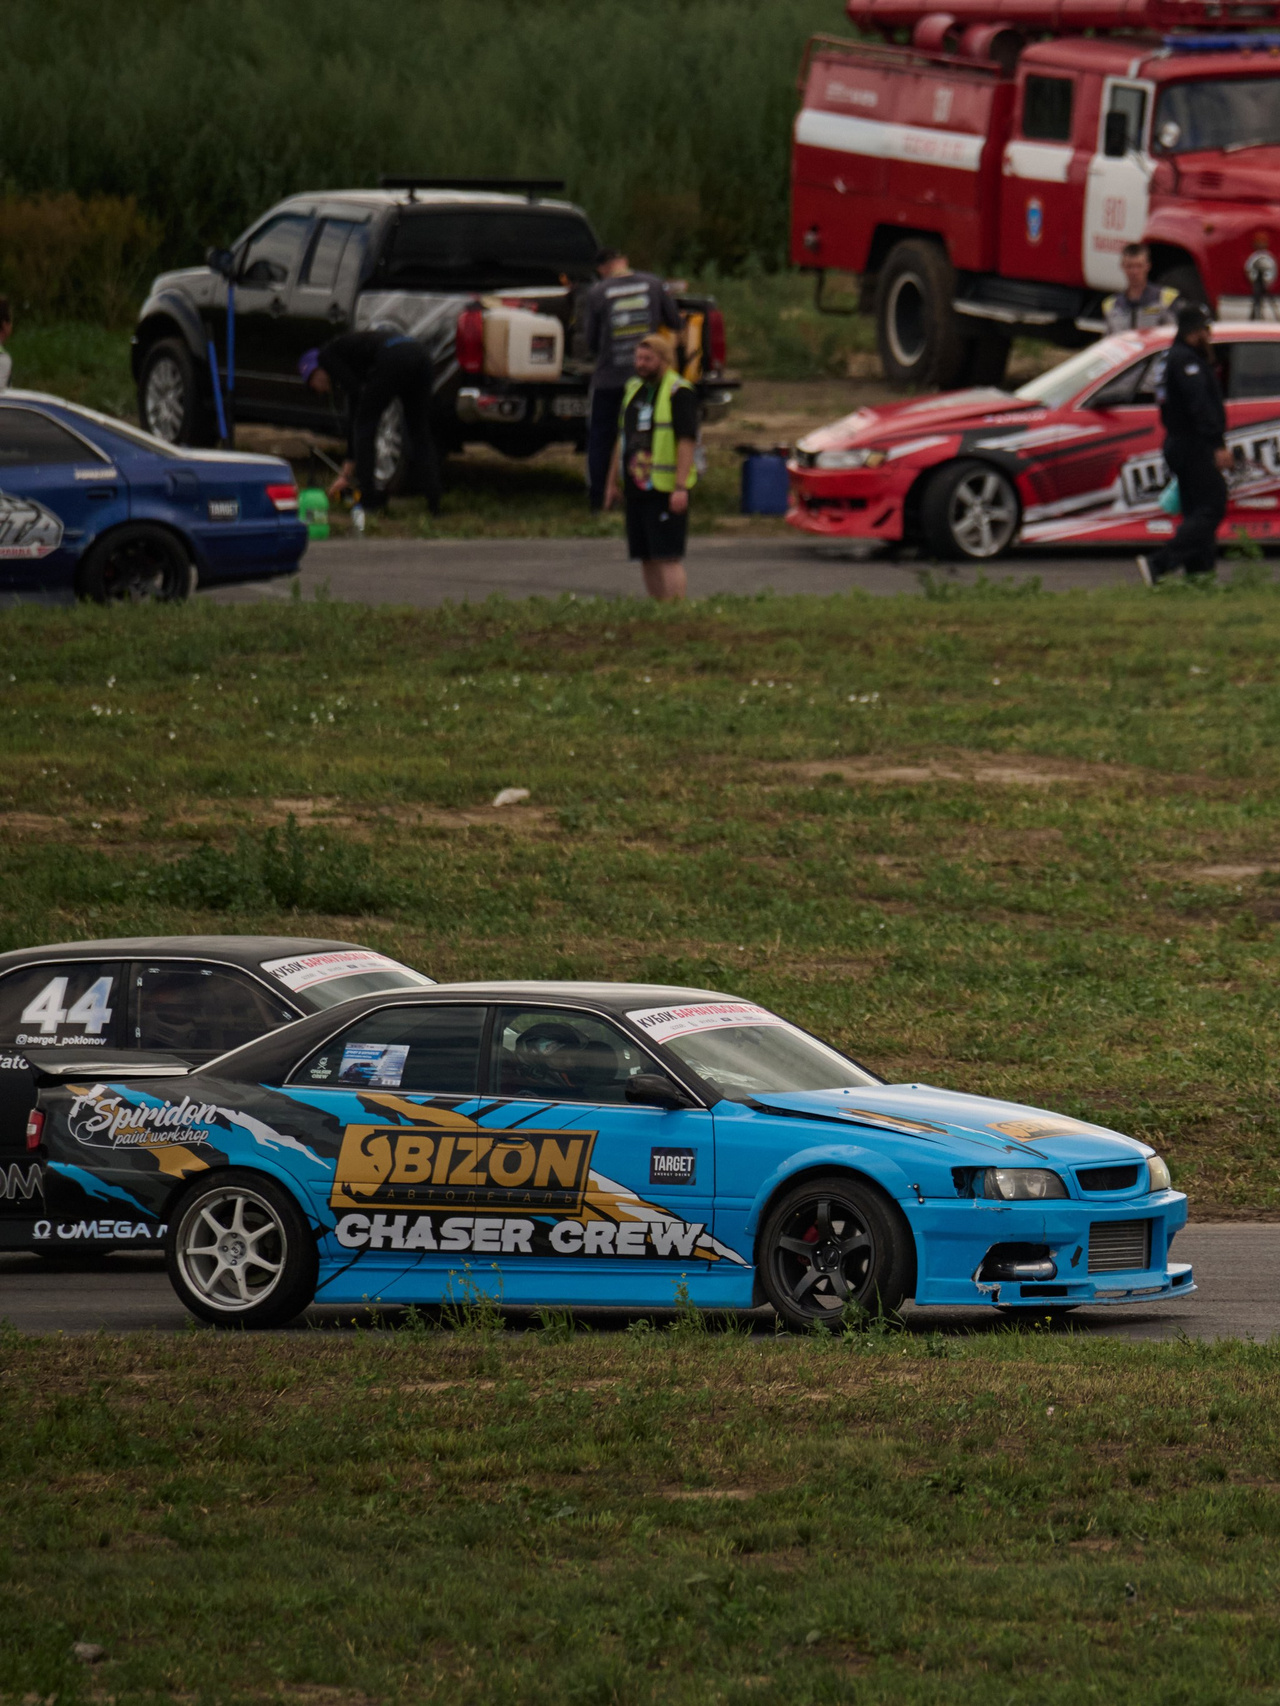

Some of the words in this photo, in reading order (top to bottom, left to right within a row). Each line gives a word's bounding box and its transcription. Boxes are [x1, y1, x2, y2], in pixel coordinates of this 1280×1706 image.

[269, 961, 306, 979] КУБОК
[20, 977, 113, 1034] 44
[637, 1010, 677, 1028] КУБОК
[86, 1095, 218, 1140] Spiridon
[112, 1129, 150, 1149] paint
[151, 1128, 209, 1146] workshop
[388, 1134, 584, 1188] BIZON
[653, 1155, 694, 1172] TARGET
[387, 1188, 573, 1204] АВТОДЕТАЛЬ
[57, 1220, 151, 1239] OMEGA
[334, 1213, 535, 1253] CHASER
[549, 1220, 705, 1257] CREW
